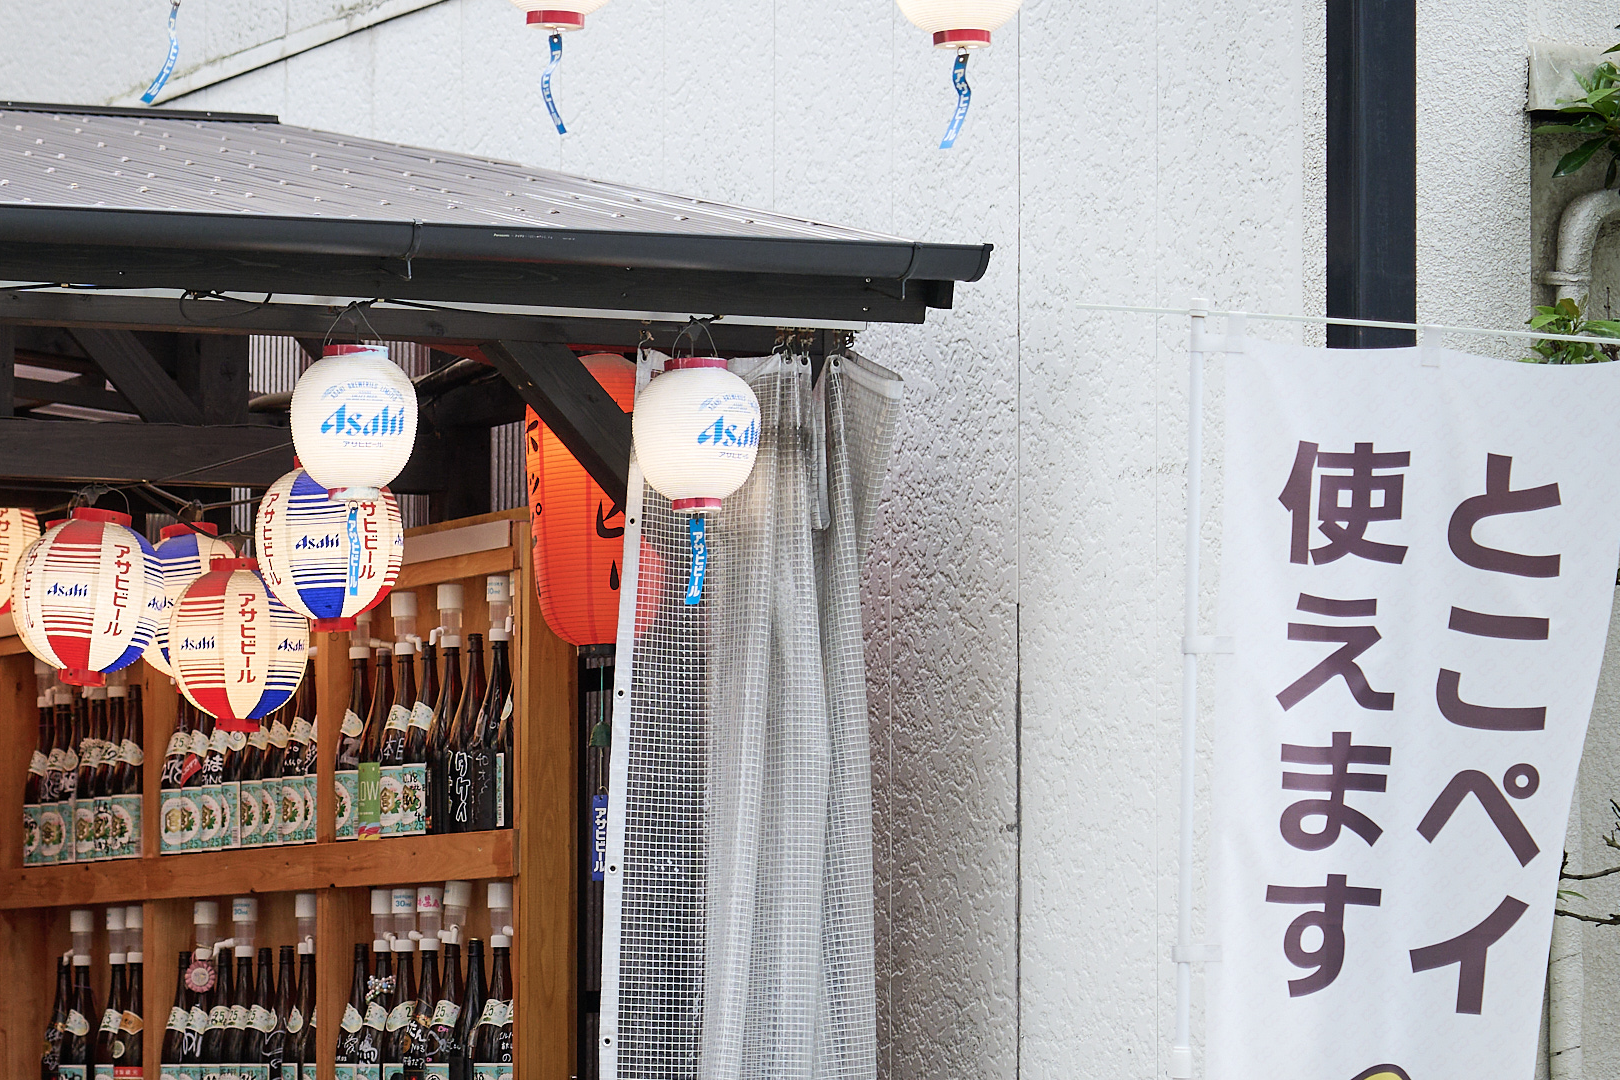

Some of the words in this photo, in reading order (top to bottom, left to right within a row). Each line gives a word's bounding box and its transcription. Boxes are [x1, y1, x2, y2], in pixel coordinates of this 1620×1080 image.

[944, 68, 968, 141] アサヒビール
[320, 404, 404, 436] Asahi
[263, 492, 282, 586] アサヒビール
[295, 533, 340, 550] Asahi
[348, 520, 359, 588] アサヒビール
[359, 501, 378, 580] サヒビール
[688, 531, 704, 597] アサヒビール
[47, 582, 89, 598] Asahi
[103, 544, 132, 637] アサヒビール
[181, 636, 215, 651] Asahi
[237, 593, 258, 684] アサヒビール
[1265, 440, 1411, 999] 使えます
[1409, 452, 1562, 1016] とこペイ
[360, 781, 380, 801] OW
[436, 1006, 447, 1018] 25
[484, 1005, 494, 1017] 25
